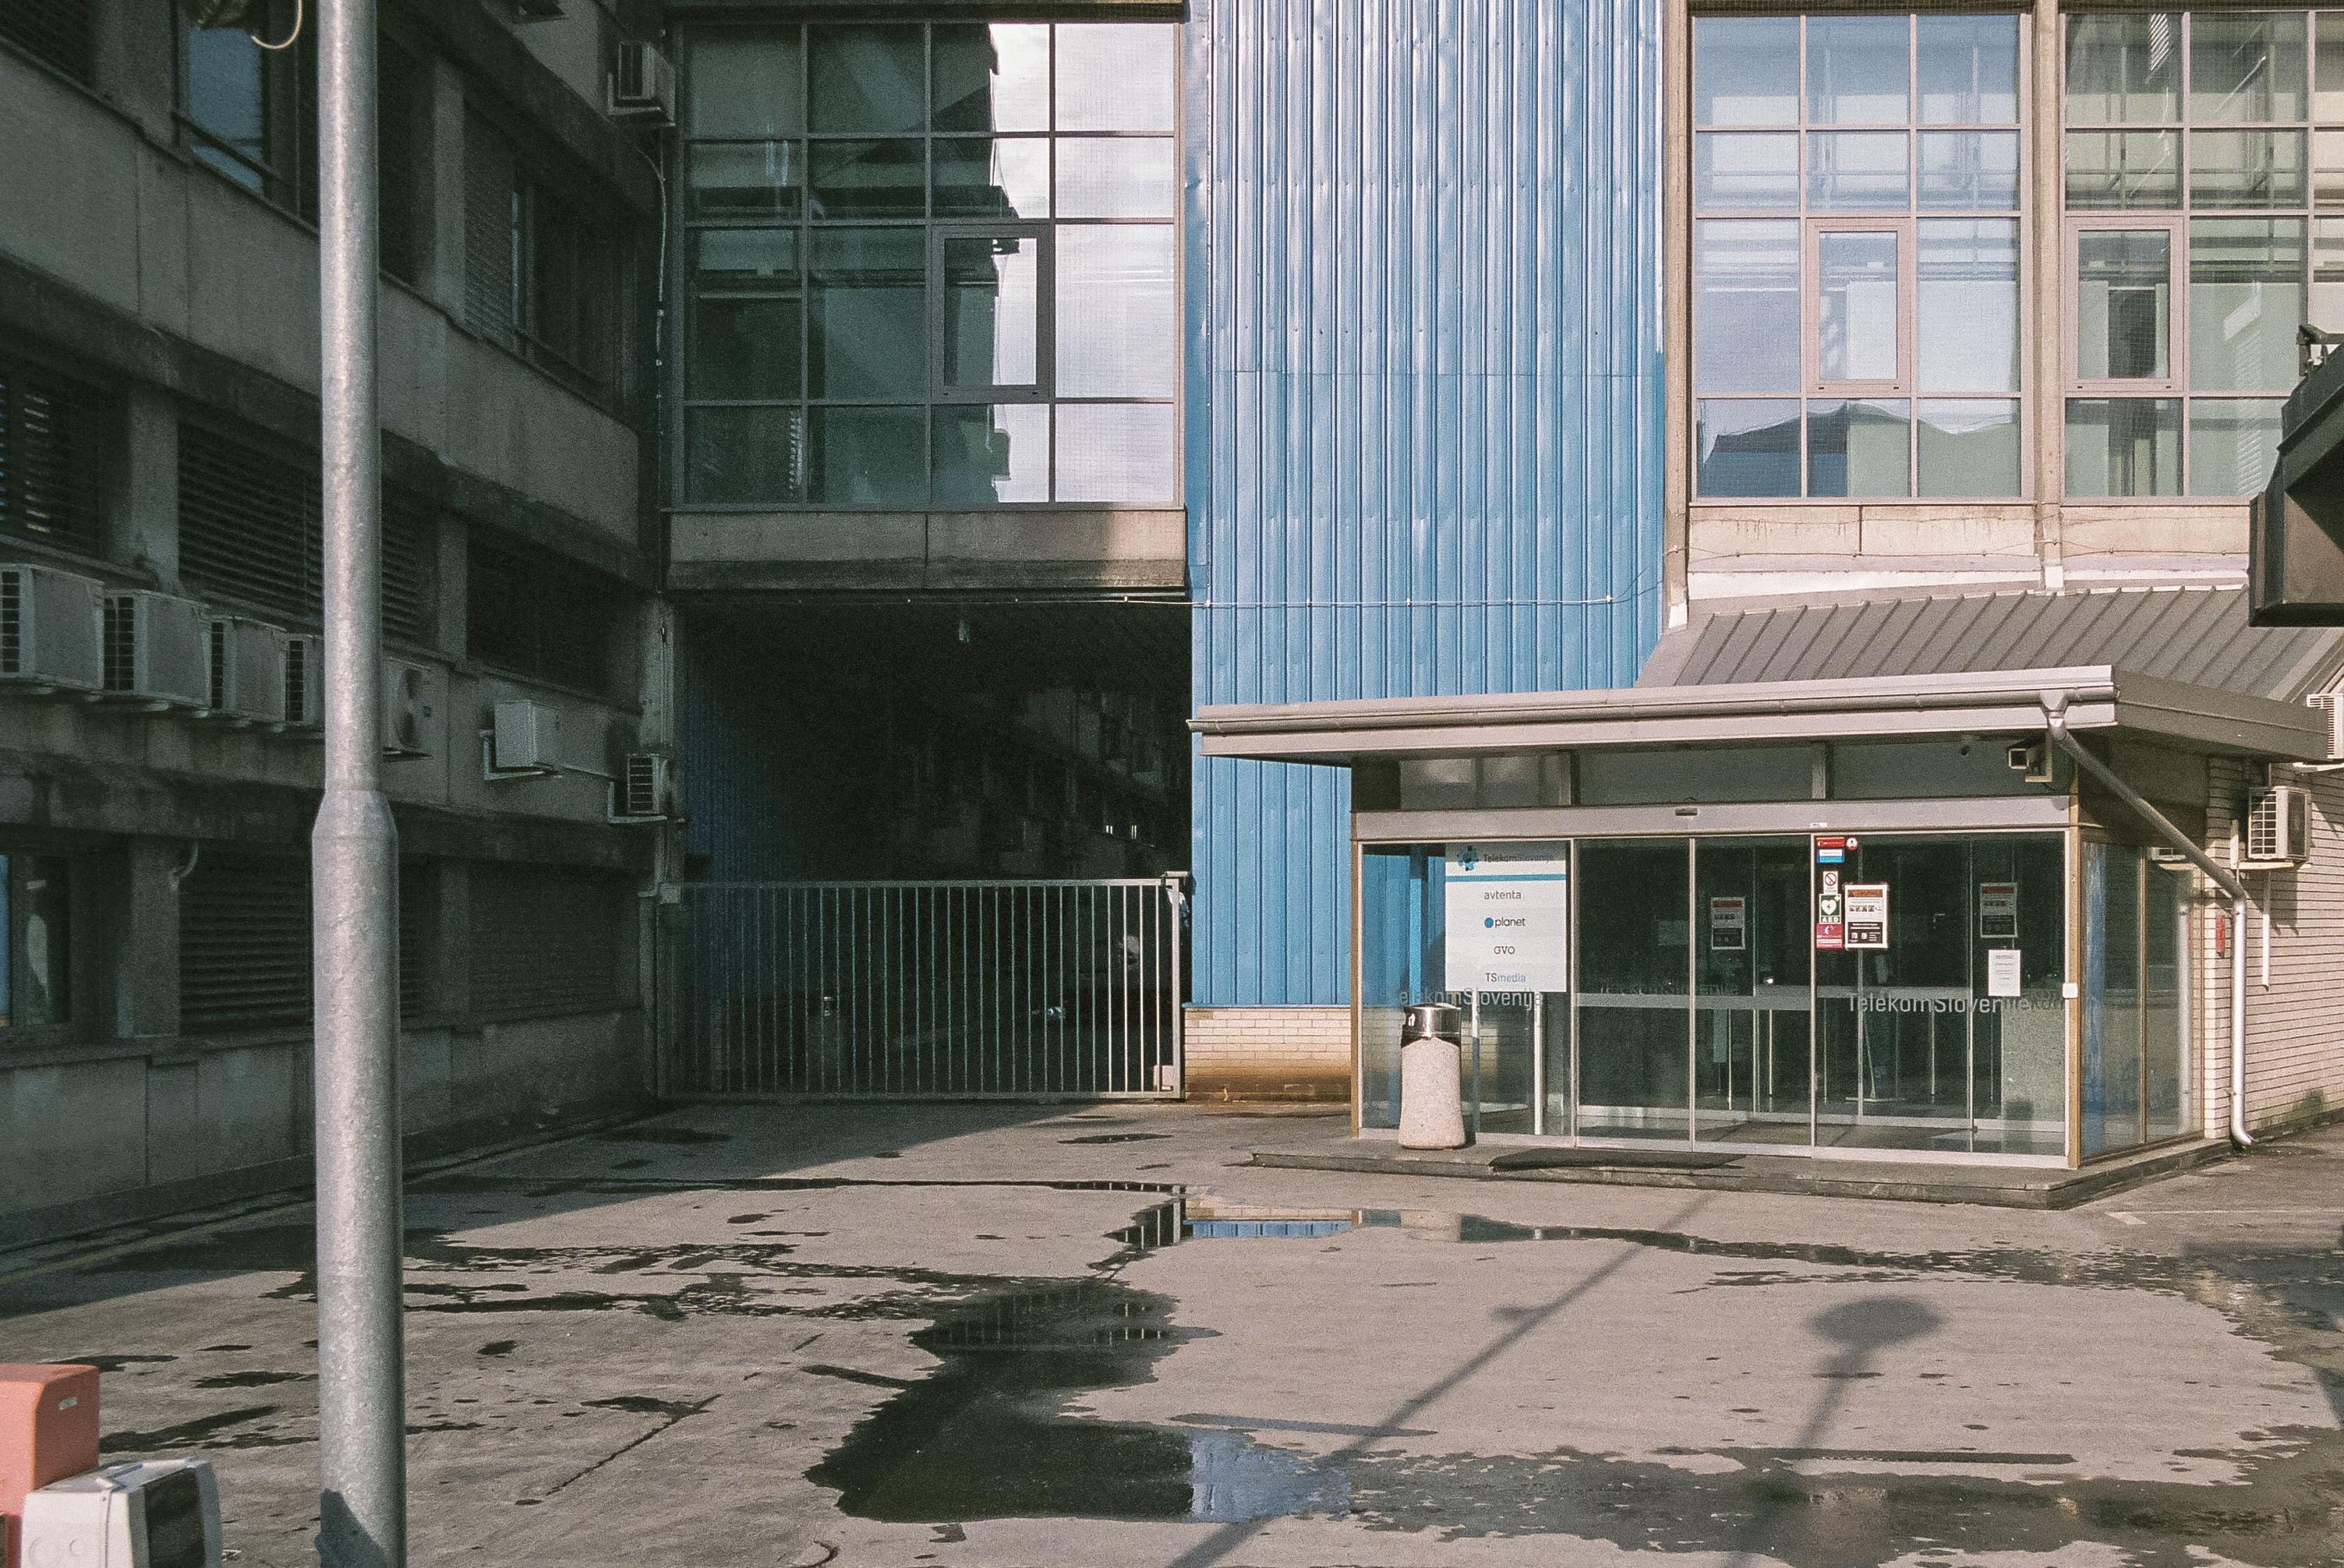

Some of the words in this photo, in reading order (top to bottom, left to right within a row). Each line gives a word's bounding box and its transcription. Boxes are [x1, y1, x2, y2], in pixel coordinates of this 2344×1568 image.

[1484, 890, 1522, 899] avtenta
[1494, 916, 1526, 928] planet
[1494, 945, 1515, 955] GVO
[1485, 972, 1526, 983] TSmedia
